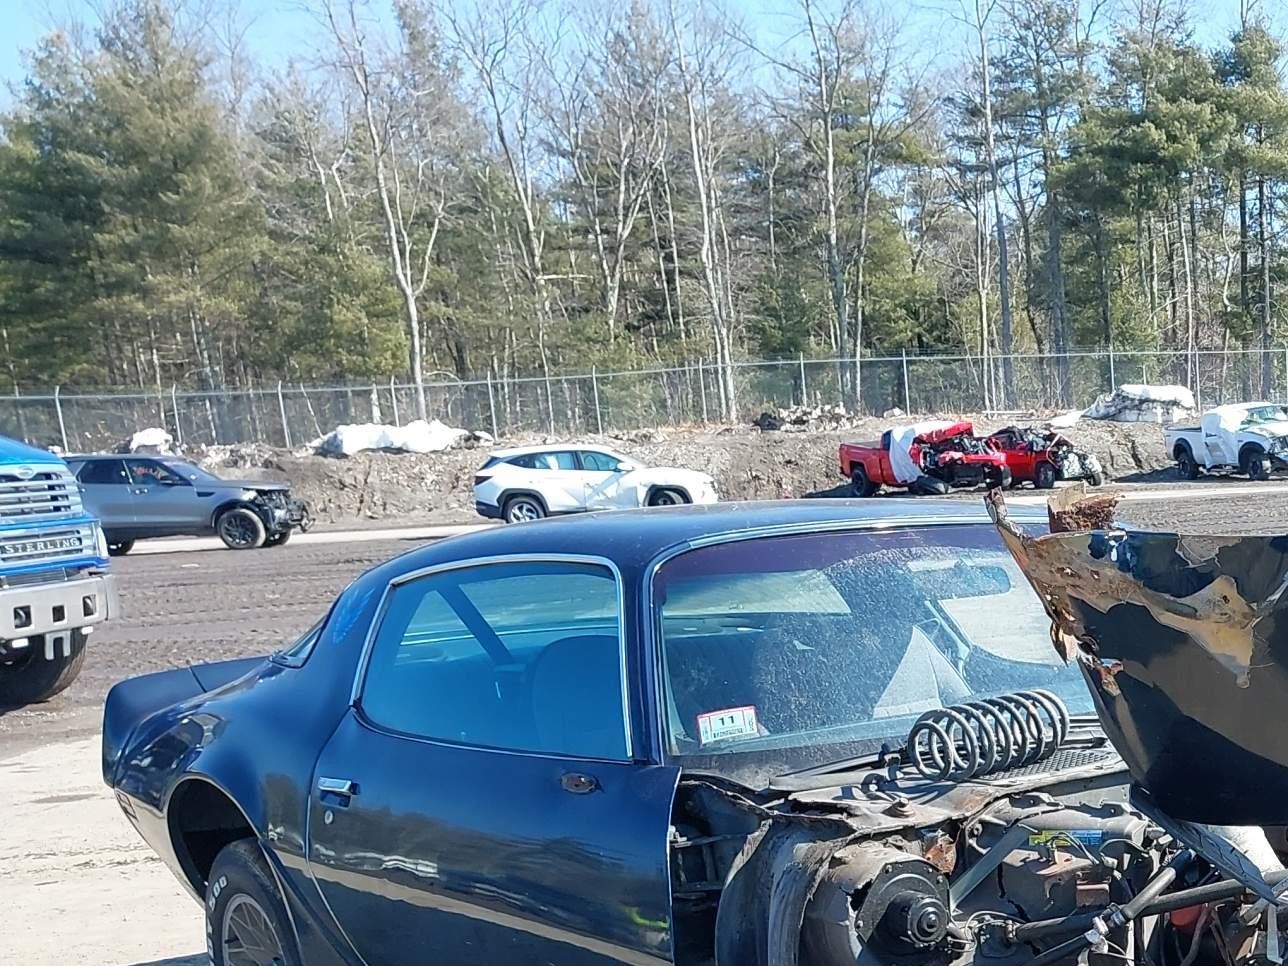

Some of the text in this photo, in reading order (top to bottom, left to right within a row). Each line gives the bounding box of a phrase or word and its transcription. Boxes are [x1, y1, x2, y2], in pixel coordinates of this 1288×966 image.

[4, 537, 80, 554] STERLING
[718, 715, 735, 727] 11
[208, 875, 228, 912] 500
